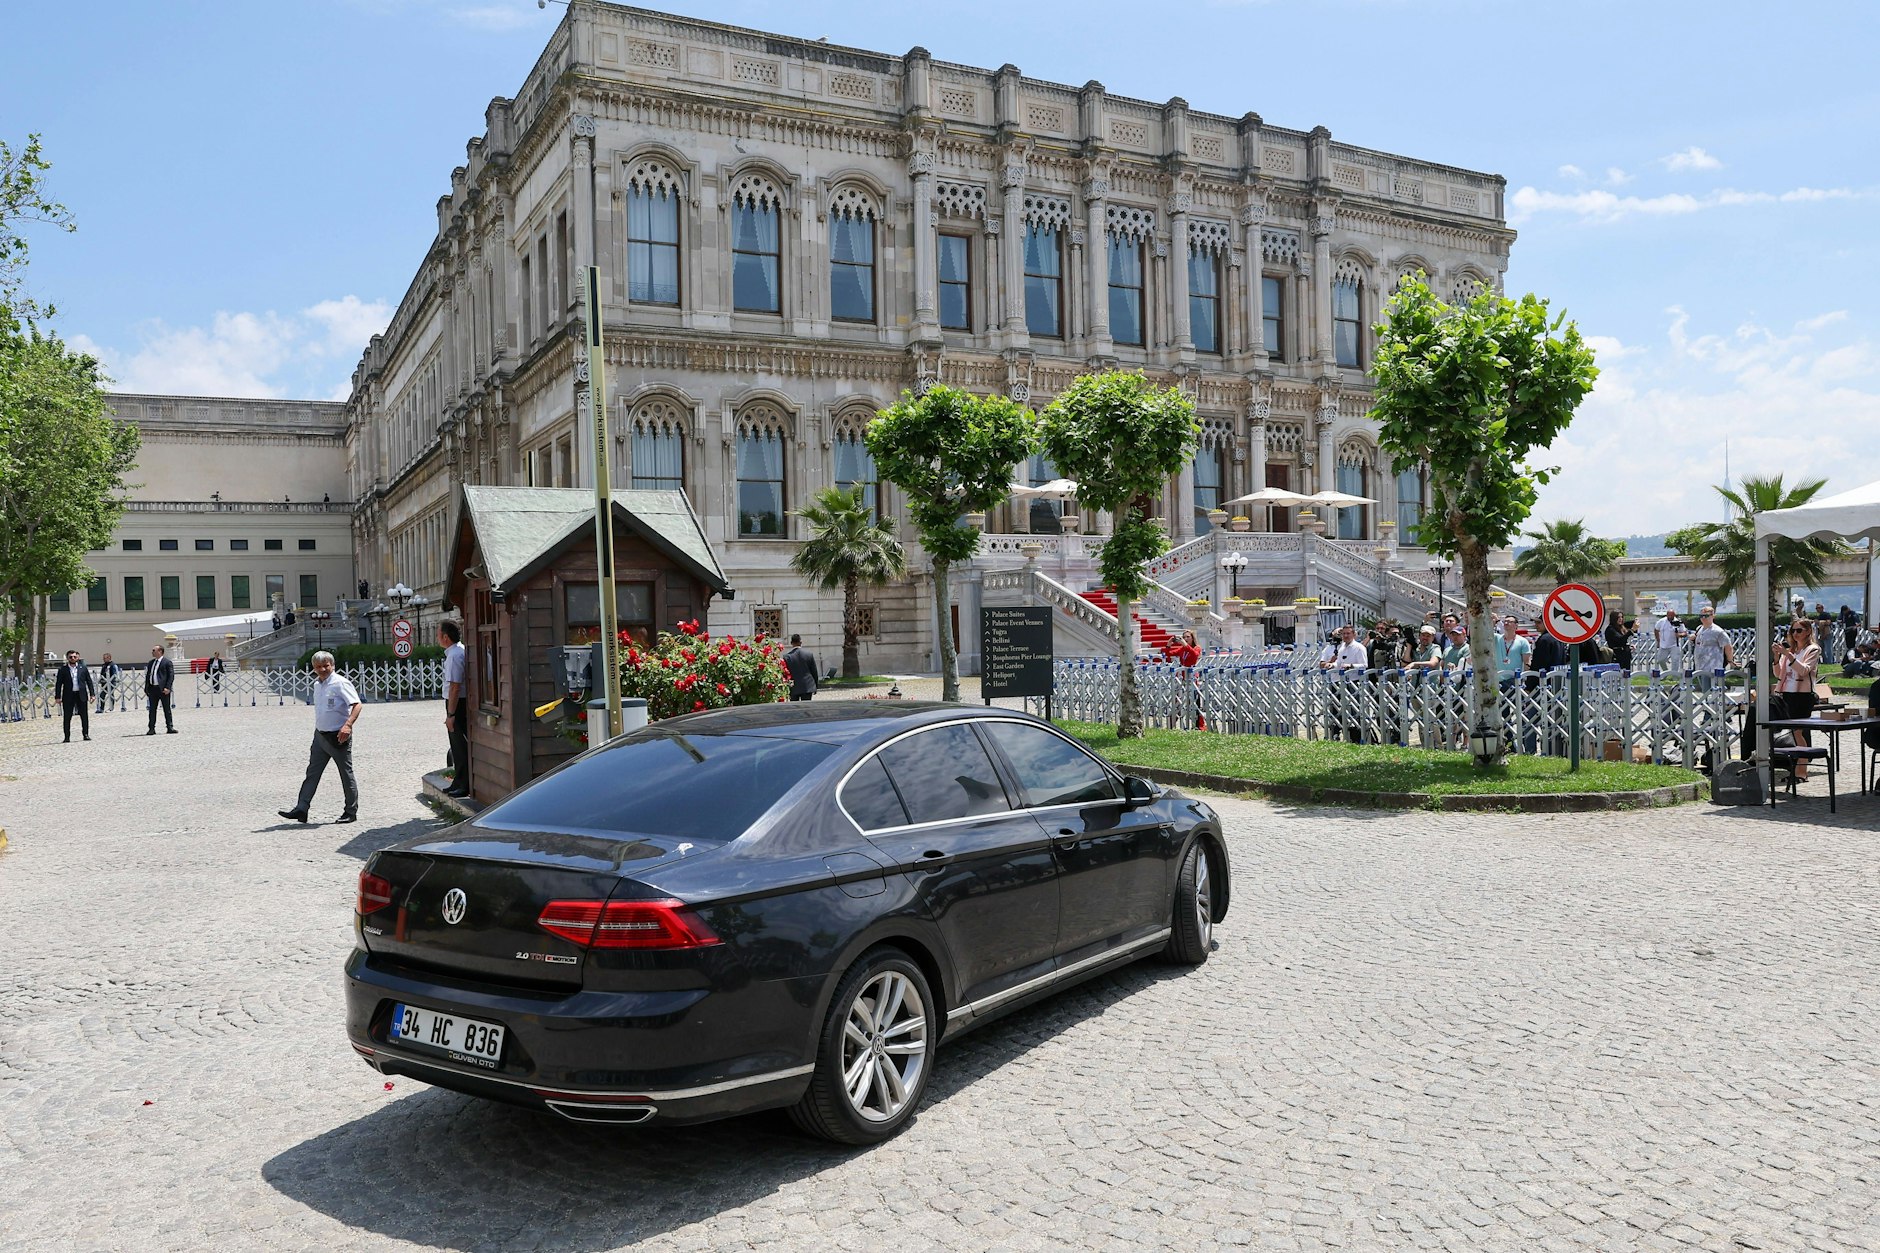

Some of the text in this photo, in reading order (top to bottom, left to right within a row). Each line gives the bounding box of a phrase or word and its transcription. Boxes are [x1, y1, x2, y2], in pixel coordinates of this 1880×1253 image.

[398, 644, 409, 652] 20
[993, 672, 1016, 680] Heliport
[516, 952, 530, 960] 2.0
[402, 1010, 420, 1038] 34
[430, 1016, 453, 1046] HC
[464, 1024, 500, 1056] 836
[478, 1060, 495, 1068] OTO
